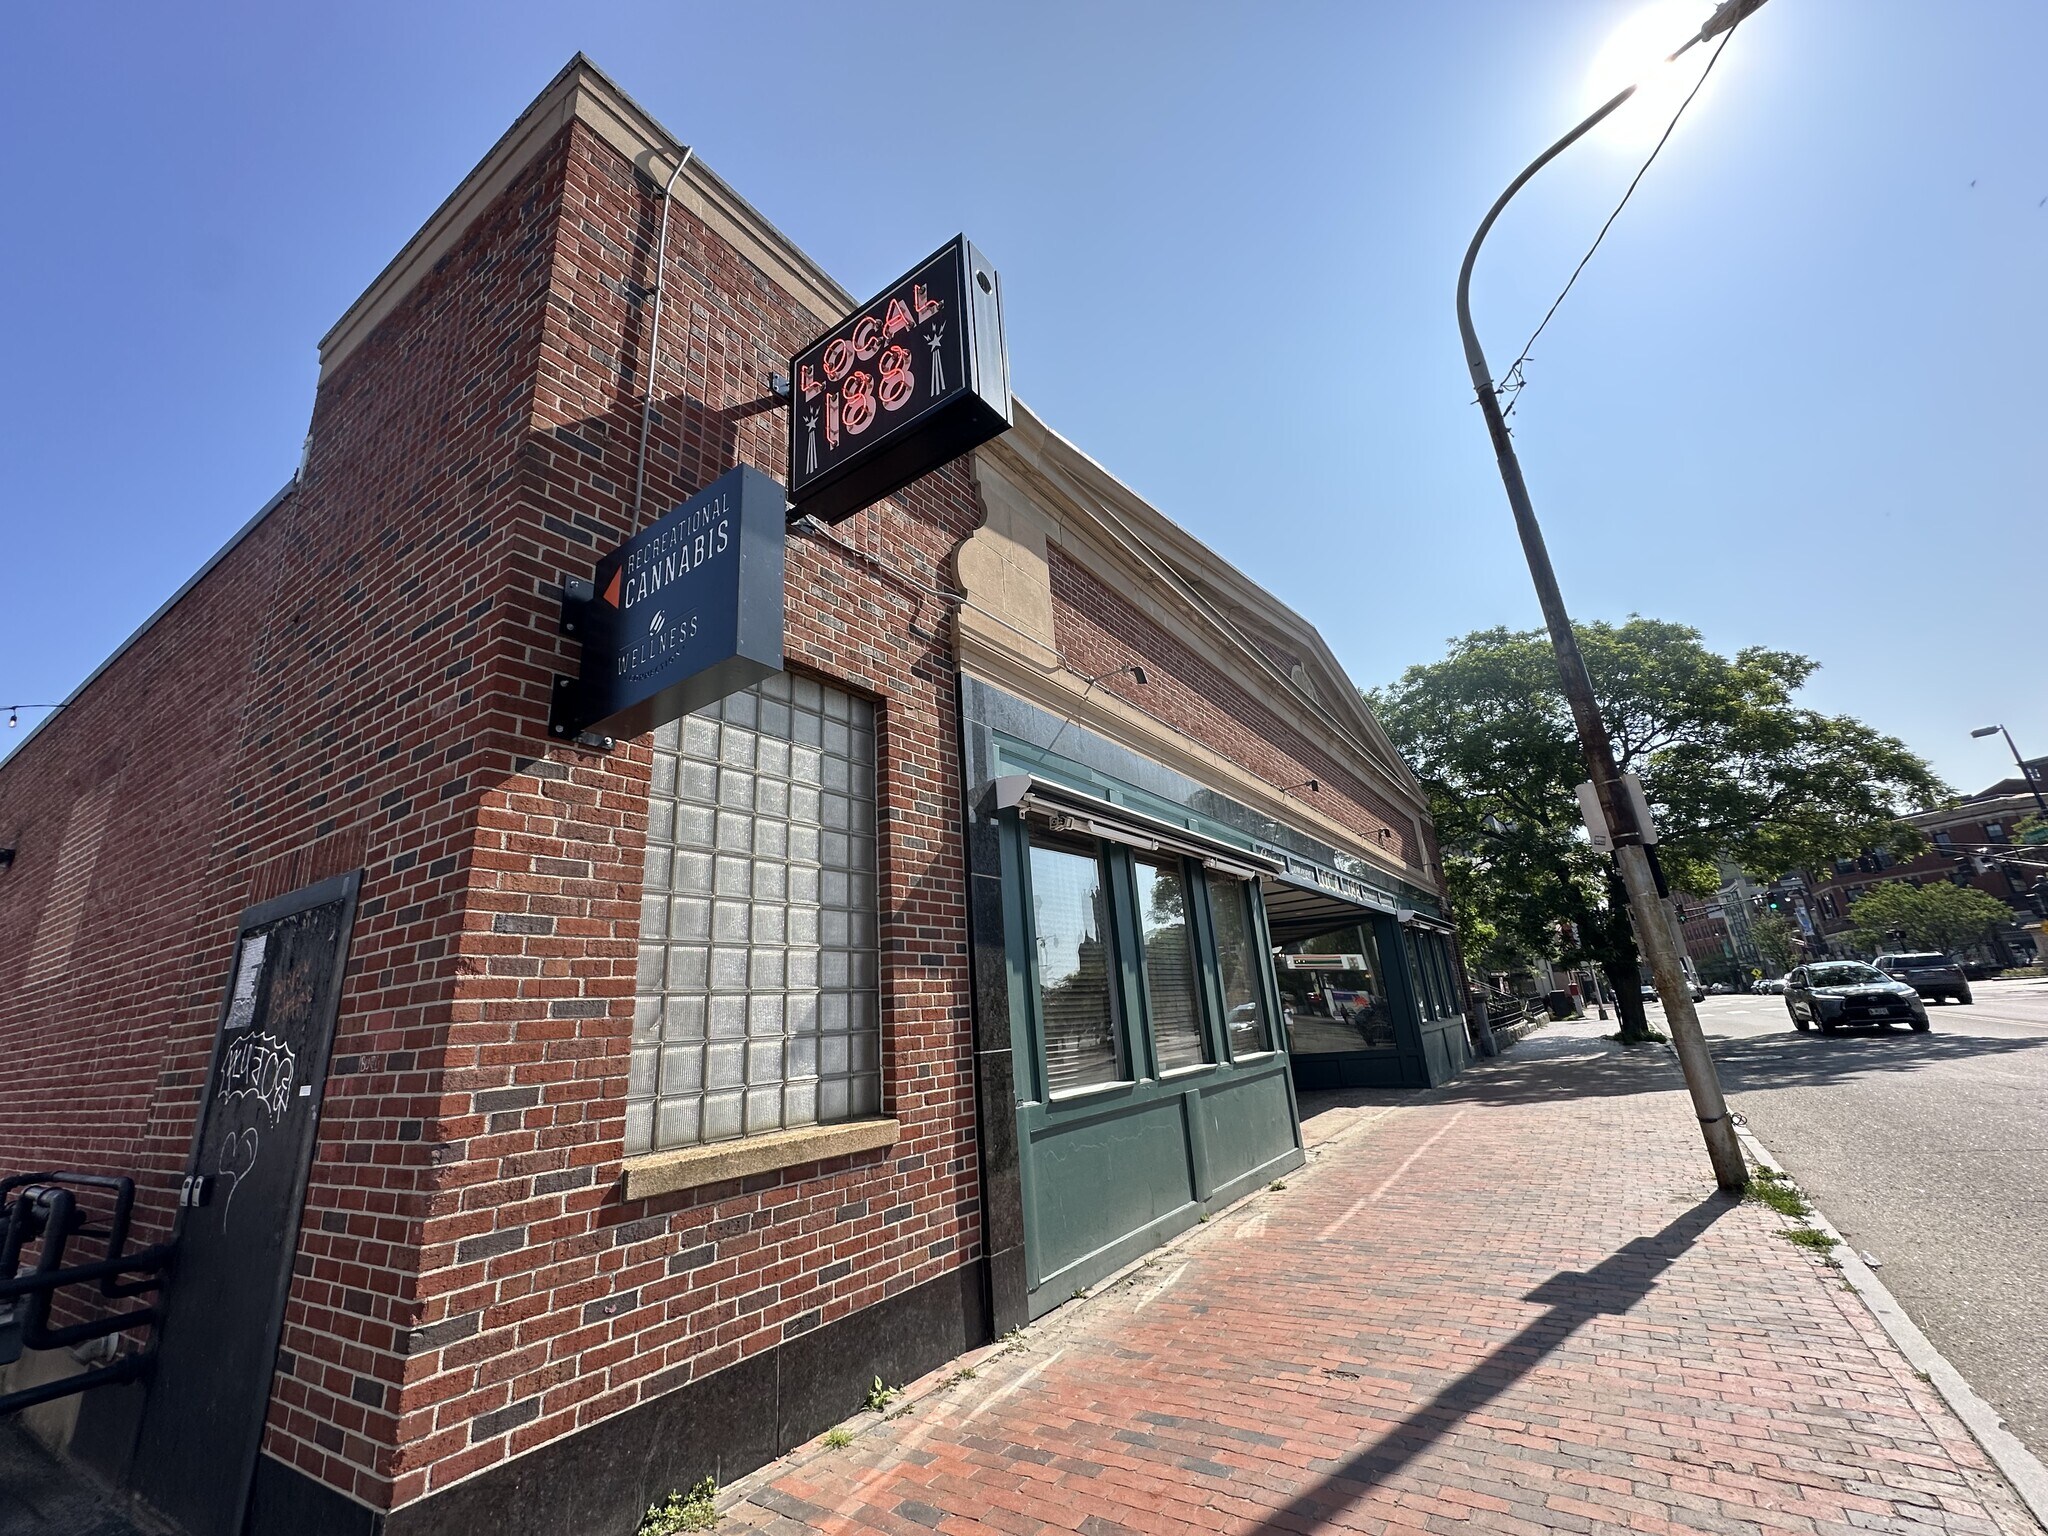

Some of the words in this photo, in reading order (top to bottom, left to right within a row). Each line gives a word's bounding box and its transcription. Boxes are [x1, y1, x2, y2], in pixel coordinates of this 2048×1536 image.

[801, 283, 944, 402] LOCAL
[826, 345, 915, 450] 188
[625, 519, 729, 609] CANNABIS
[627, 493, 730, 575] RECREATIONAL
[618, 615, 698, 675] WELLNESS
